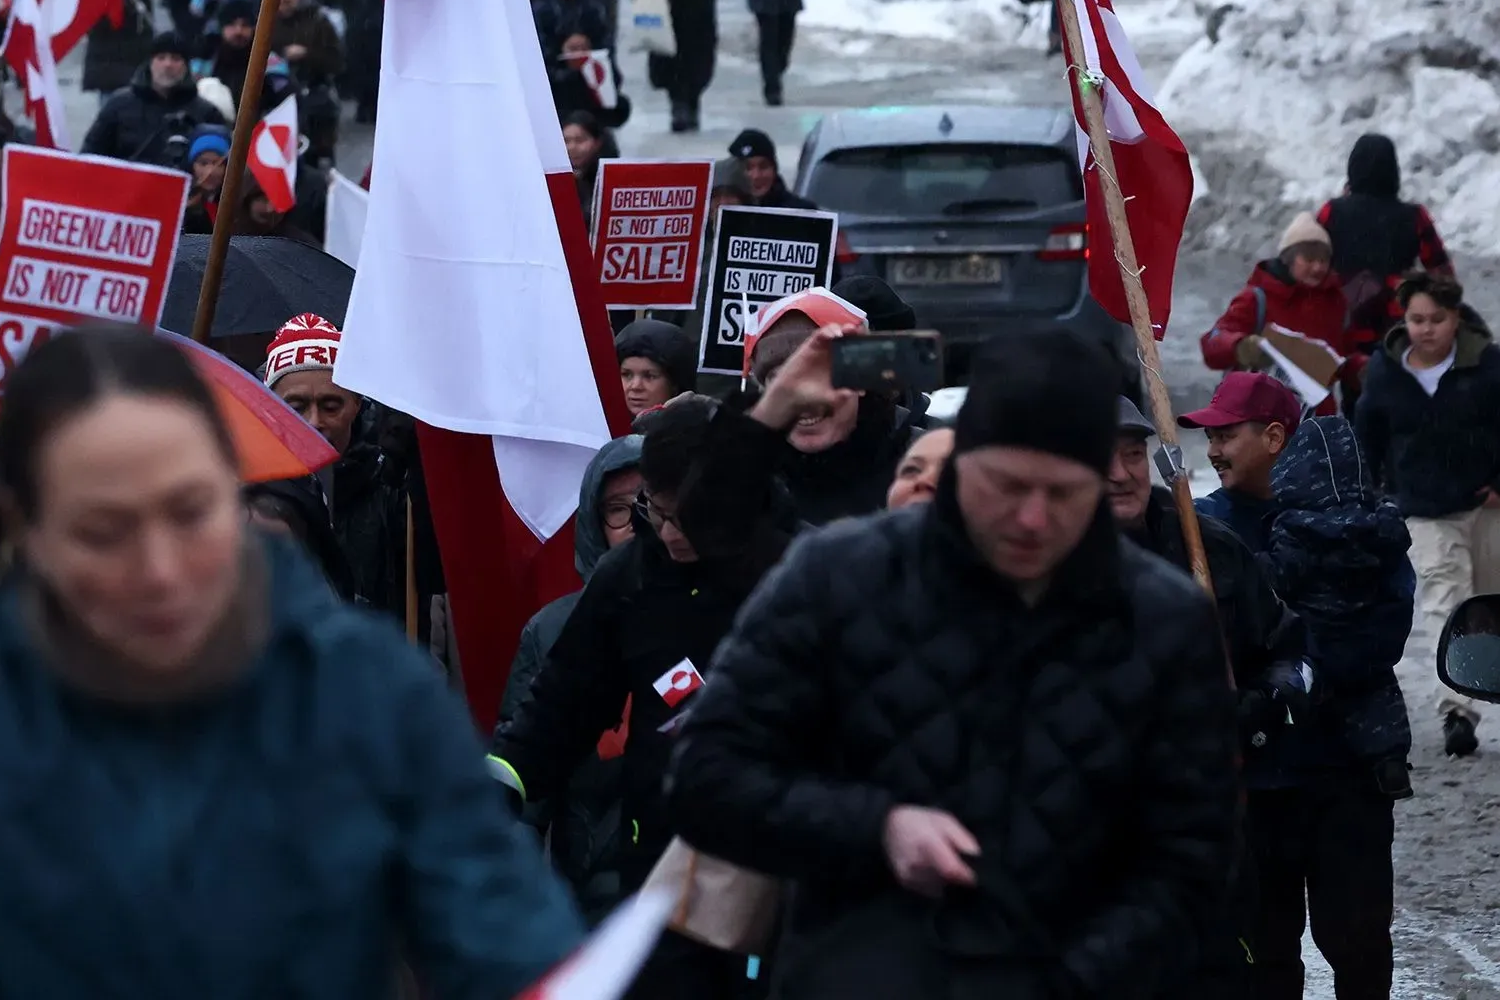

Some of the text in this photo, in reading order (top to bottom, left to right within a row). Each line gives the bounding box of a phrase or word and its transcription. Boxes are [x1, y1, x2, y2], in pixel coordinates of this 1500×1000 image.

[613, 188, 694, 208] GREENLAND
[24, 207, 154, 258] GREENLAND
[610, 217, 690, 235] IS NOT FOR
[604, 245, 687, 281] SALE!
[730, 239, 816, 265] GREENLAND
[9, 263, 140, 317] IS NOT FOR
[727, 270, 811, 294] IS NOT FOR
